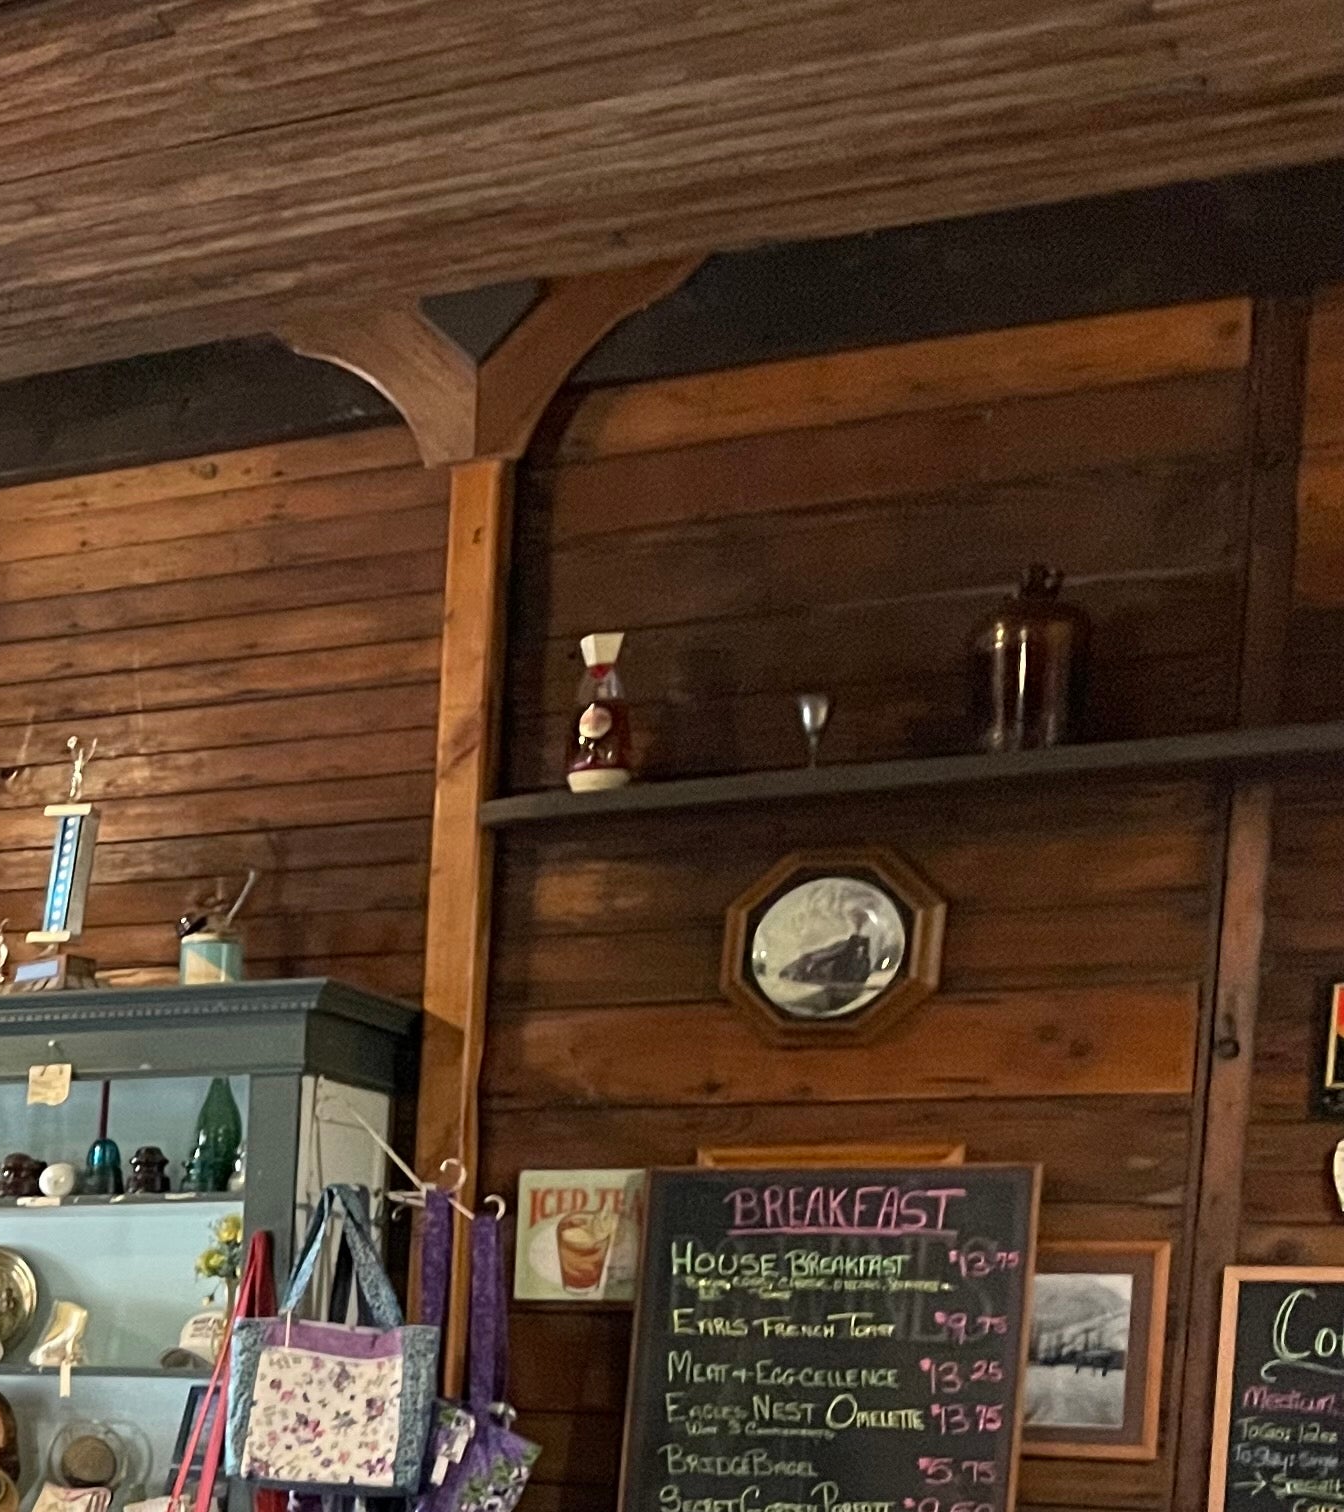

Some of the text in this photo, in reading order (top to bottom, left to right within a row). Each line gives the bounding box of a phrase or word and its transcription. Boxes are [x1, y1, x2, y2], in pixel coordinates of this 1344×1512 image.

[723, 1186, 967, 1230] BREAKFAST
[671, 1241, 777, 1277] HOUSE
[784, 1250, 911, 1277] BREAKFAST
[753, 1315, 835, 1339] FRENCH
[827, 1312, 897, 1339] TOAST
[667, 1351, 727, 1384] MEAT
[752, 1394, 817, 1423] NEST
[825, 1393, 926, 1432] OMELETTE
[657, 1443, 749, 1476] BRIDGE
